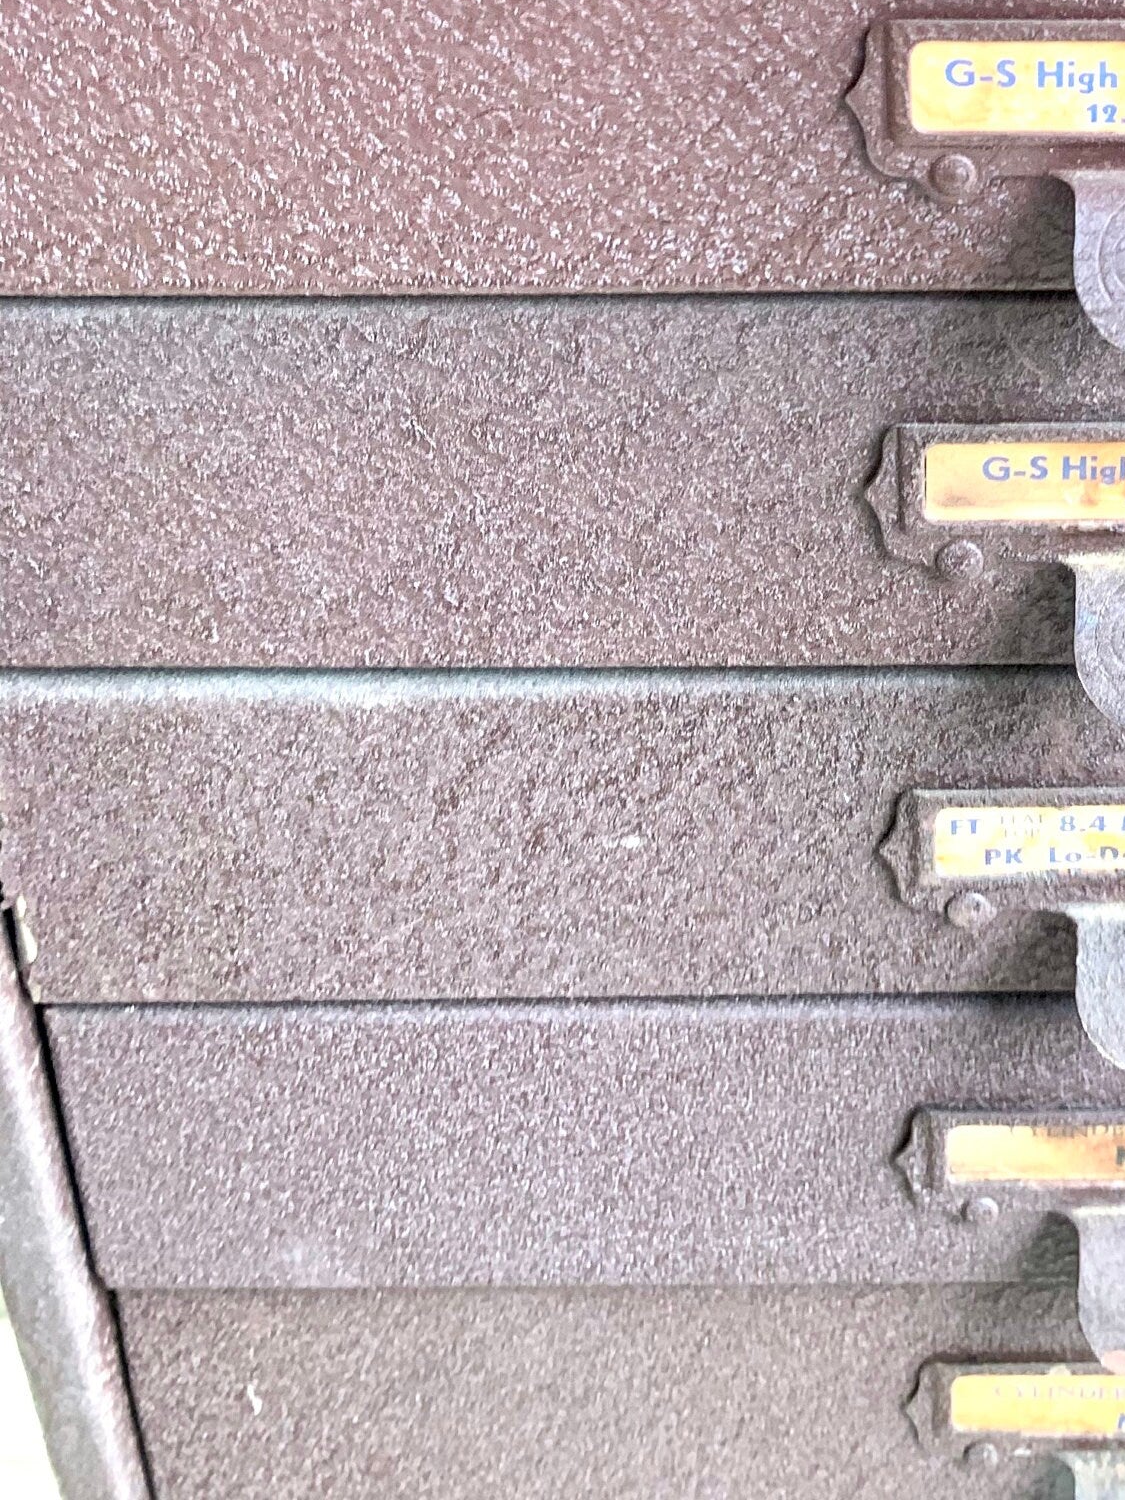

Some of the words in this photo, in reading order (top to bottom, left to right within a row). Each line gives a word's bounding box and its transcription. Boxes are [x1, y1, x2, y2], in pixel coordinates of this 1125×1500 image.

[944, 59, 1017, 88] G-S
[1037, 60, 1118, 95] High
[982, 455, 1049, 482] G-S
[950, 818, 978, 836] FT
[984, 847, 1023, 866] PK
